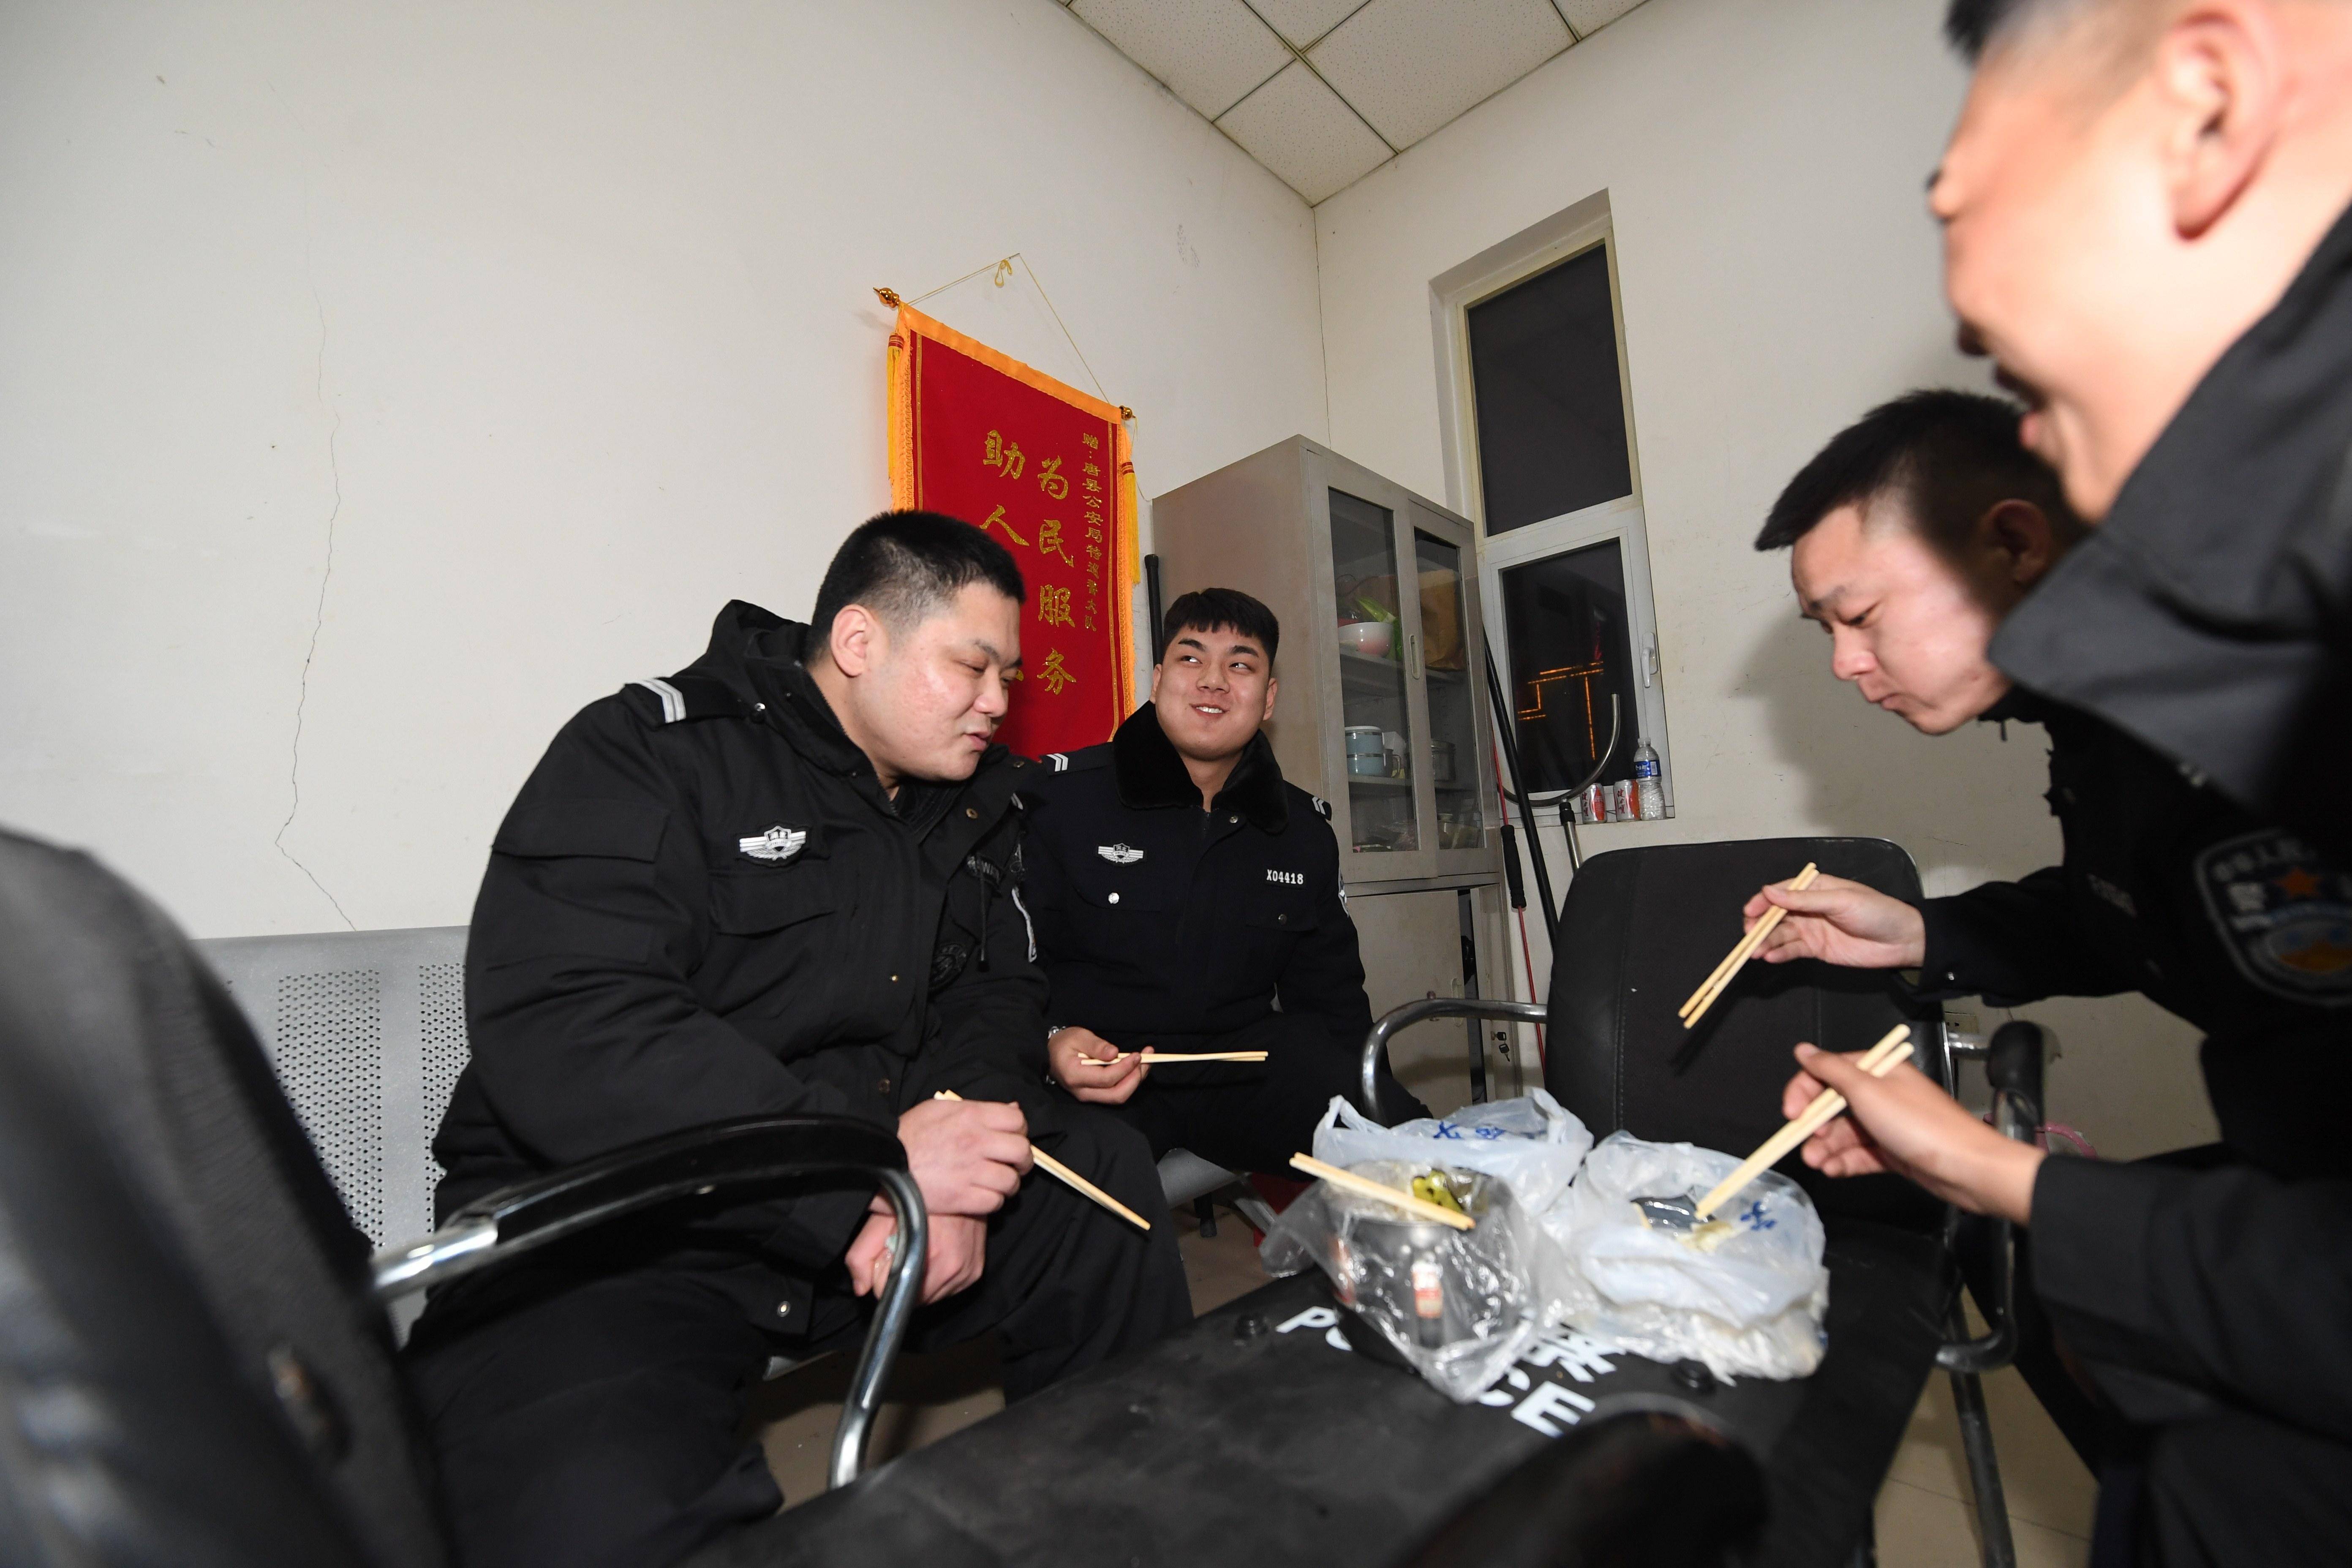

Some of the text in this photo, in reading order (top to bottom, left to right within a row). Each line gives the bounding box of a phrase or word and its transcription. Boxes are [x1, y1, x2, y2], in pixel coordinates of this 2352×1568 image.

[1037, 456, 1077, 695] 为民服务
[1266, 869, 1304, 885] X04418
